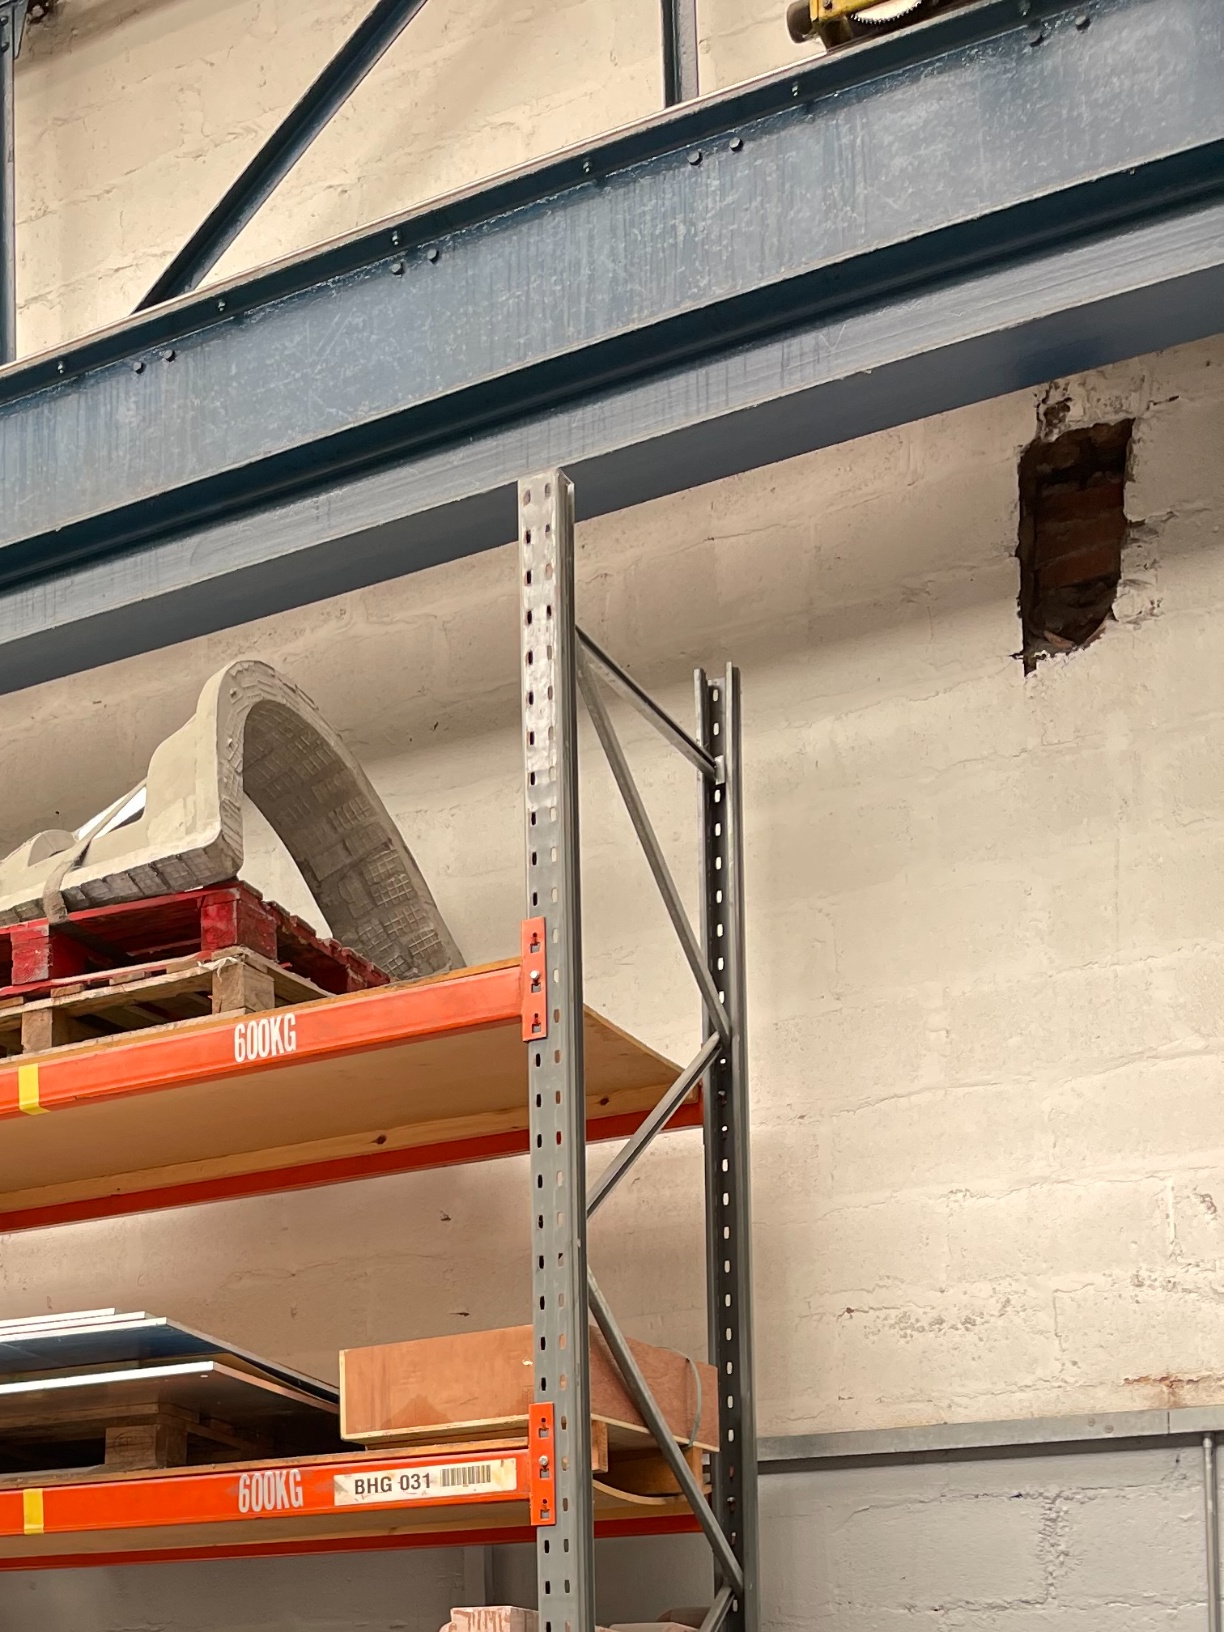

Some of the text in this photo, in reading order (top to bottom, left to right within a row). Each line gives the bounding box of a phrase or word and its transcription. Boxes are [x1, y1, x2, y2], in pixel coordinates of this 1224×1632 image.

[234, 1013, 296, 1062] 600KG
[238, 1468, 304, 1514] 600KG
[354, 1472, 431, 1495] BHG 031
